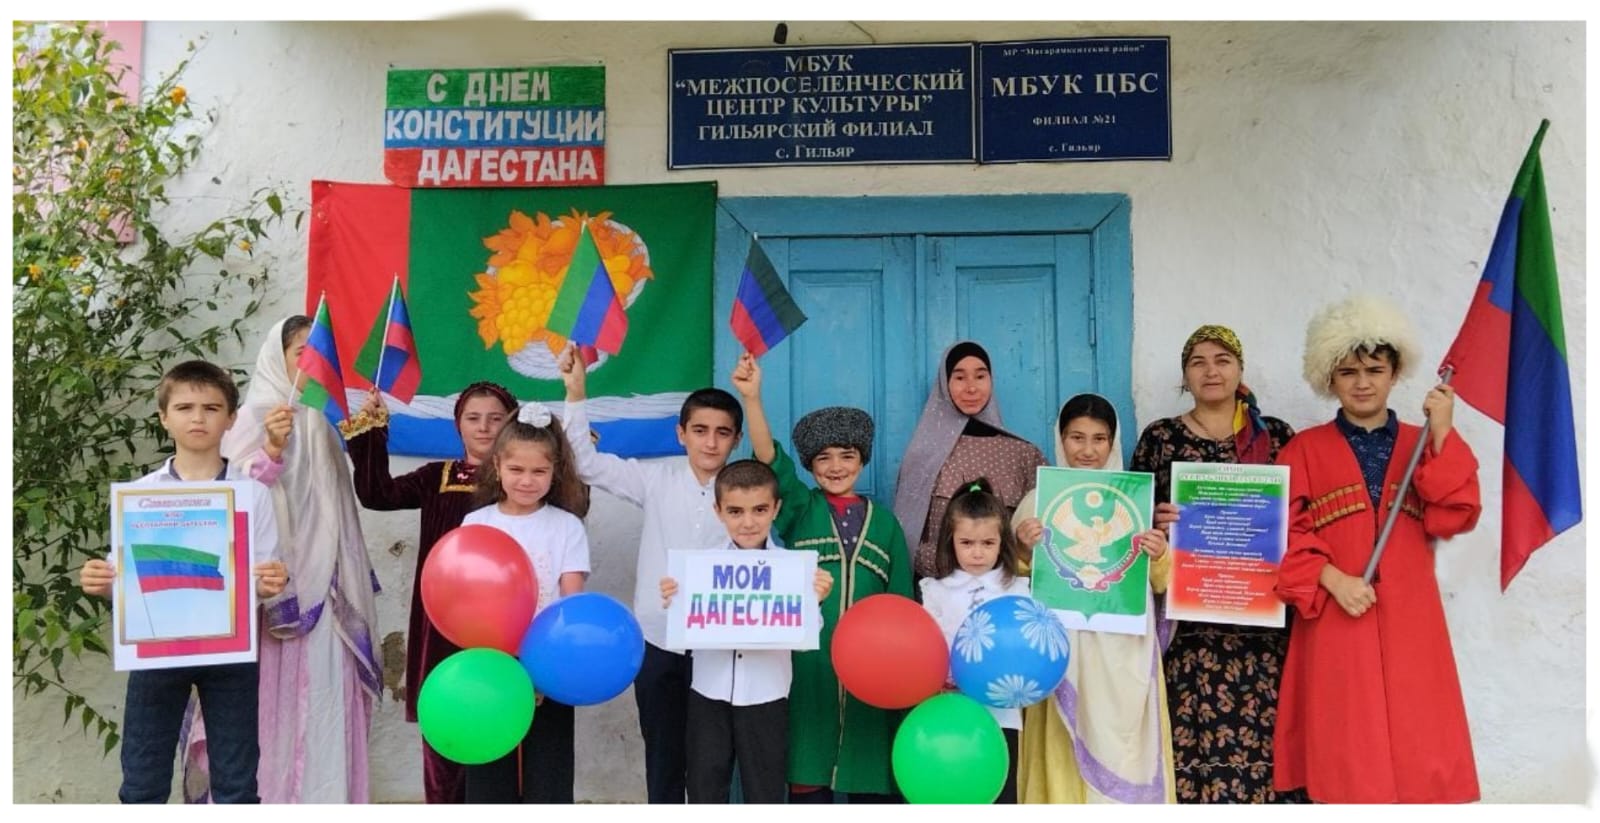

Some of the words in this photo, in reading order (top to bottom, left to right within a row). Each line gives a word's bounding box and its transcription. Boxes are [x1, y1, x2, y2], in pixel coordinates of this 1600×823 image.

[785, 53, 854, 73] МБУК
[426, 73, 448, 103] С
[463, 70, 551, 107] ДНЕМ
[675, 69, 965, 97] “МЕЖПОСЕЛЕНЧЕСКИЙ
[991, 73, 1084, 98] МБУК
[1095, 72, 1159, 98] ЦБС
[706, 98, 786, 119] ЦЕНТР
[791, 94, 933, 115] КУЛЬТУРЫ”
[1032, 115, 1089, 126] ФИЛИАЛ
[1091, 114, 1117, 125] №21
[385, 109, 605, 143] КОНСТИТУЦИИ
[698, 119, 837, 141] ГИЛЬЯРСКИЙ
[842, 120, 934, 138] ФИЛИАЛ
[417, 148, 598, 186] ДАГЕСТАНА
[776, 148, 790, 159] с.
[712, 560, 772, 591] МОЙ
[686, 593, 803, 629] ДАГЕСТАН
